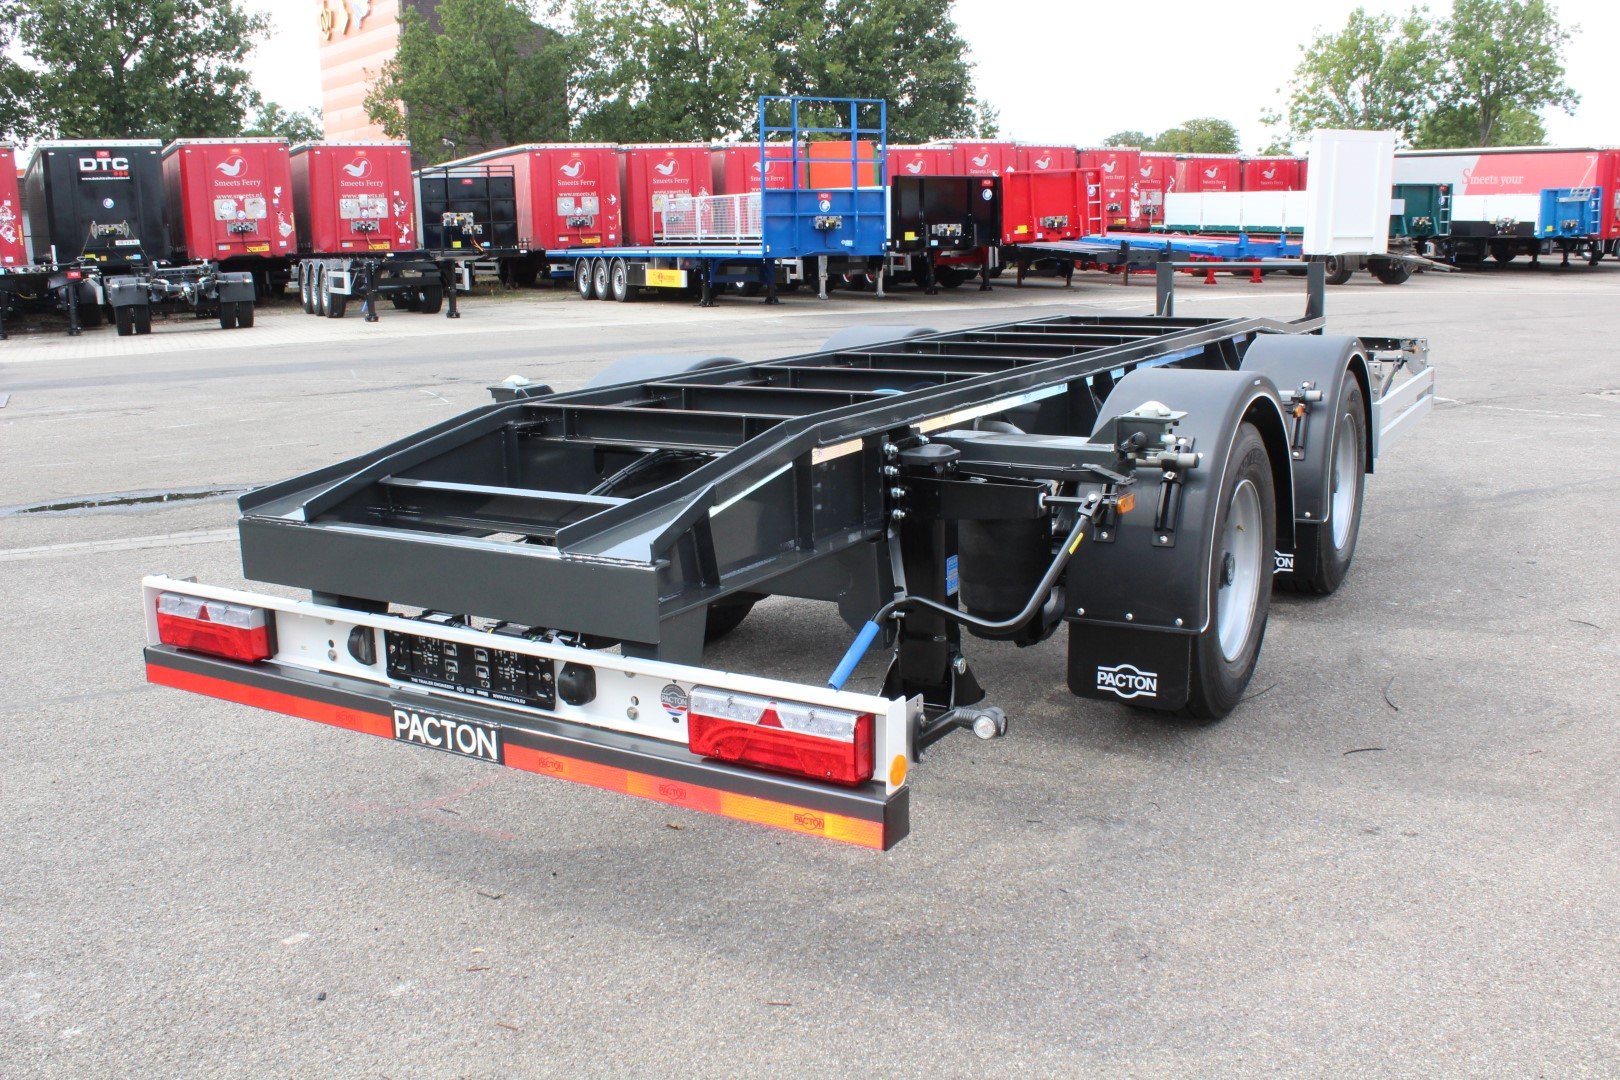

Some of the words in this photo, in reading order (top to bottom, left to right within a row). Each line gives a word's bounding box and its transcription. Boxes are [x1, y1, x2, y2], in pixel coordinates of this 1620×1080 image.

[79, 157, 129, 171] DTC
[242, 179, 261, 188] Ferry
[366, 179, 384, 188] Ferry
[580, 179, 596, 187] Ferry
[1500, 175, 1524, 187] your
[418, 678, 434, 686] TRAILER
[1097, 671, 1157, 692] PACTON
[661, 694, 688, 706] PACTON
[393, 709, 498, 760] PACTON
[794, 813, 825, 830] PACTON
